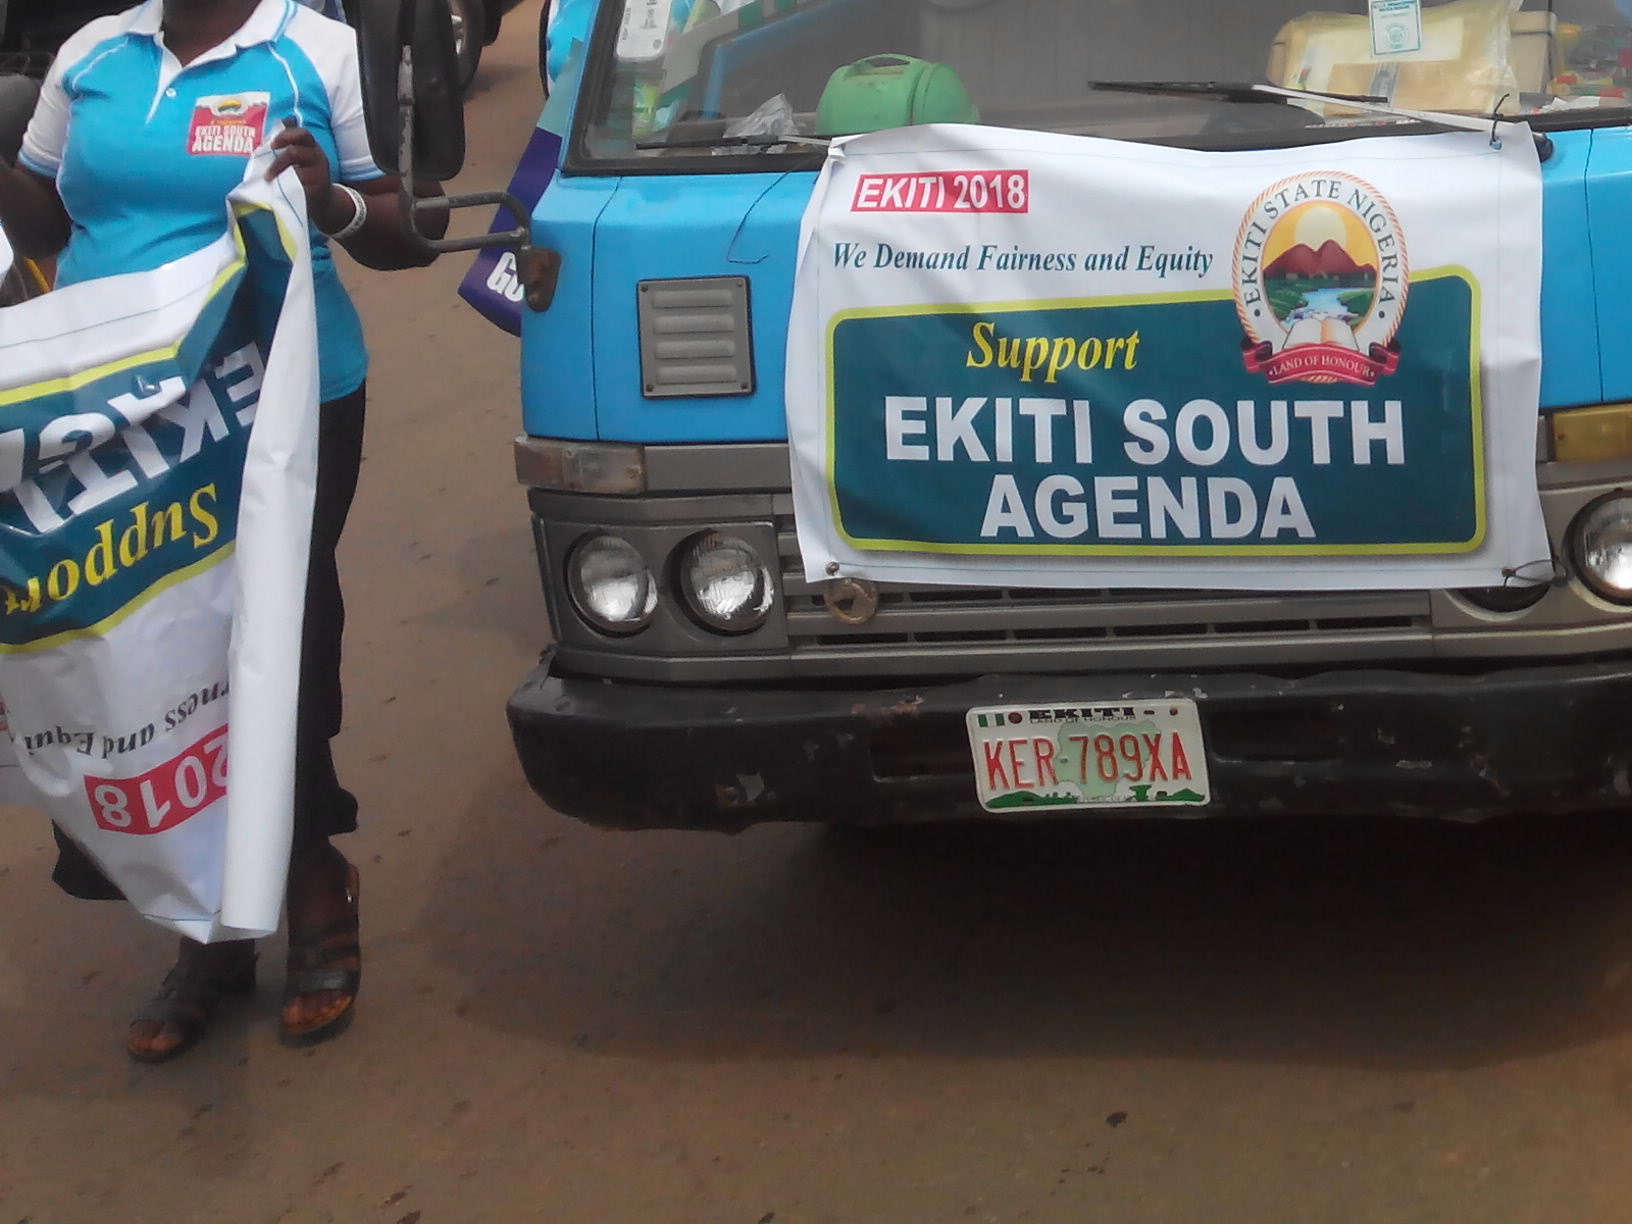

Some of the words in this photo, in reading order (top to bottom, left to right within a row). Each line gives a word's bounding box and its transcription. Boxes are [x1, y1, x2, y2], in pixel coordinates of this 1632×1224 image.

[191, 135, 254, 154] AGENDA
[856, 175, 945, 209] EKITI
[953, 173, 1026, 210] 2018
[832, 242, 867, 269] We
[873, 242, 971, 271] Demand
[976, 243, 1077, 272] Fairness
[1084, 245, 1129, 272] and
[1135, 245, 1214, 279] Equity
[1241, 221, 1266, 307] EKITI
[1263, 178, 1342, 221] STATE
[1348, 188, 1399, 304] NIGERIA
[966, 320, 1141, 384] Support
[1272, 356, 1303, 375] LAND
[1304, 355, 1320, 366] OF
[1322, 354, 1370, 377] HONOUR
[884, 394, 1094, 465] EKITI
[1122, 397, 1406, 466] SOUTH
[978, 472, 1318, 540] AGENDA
[1028, 707, 1136, 720] EKITI
[101, 722, 156, 760] and
